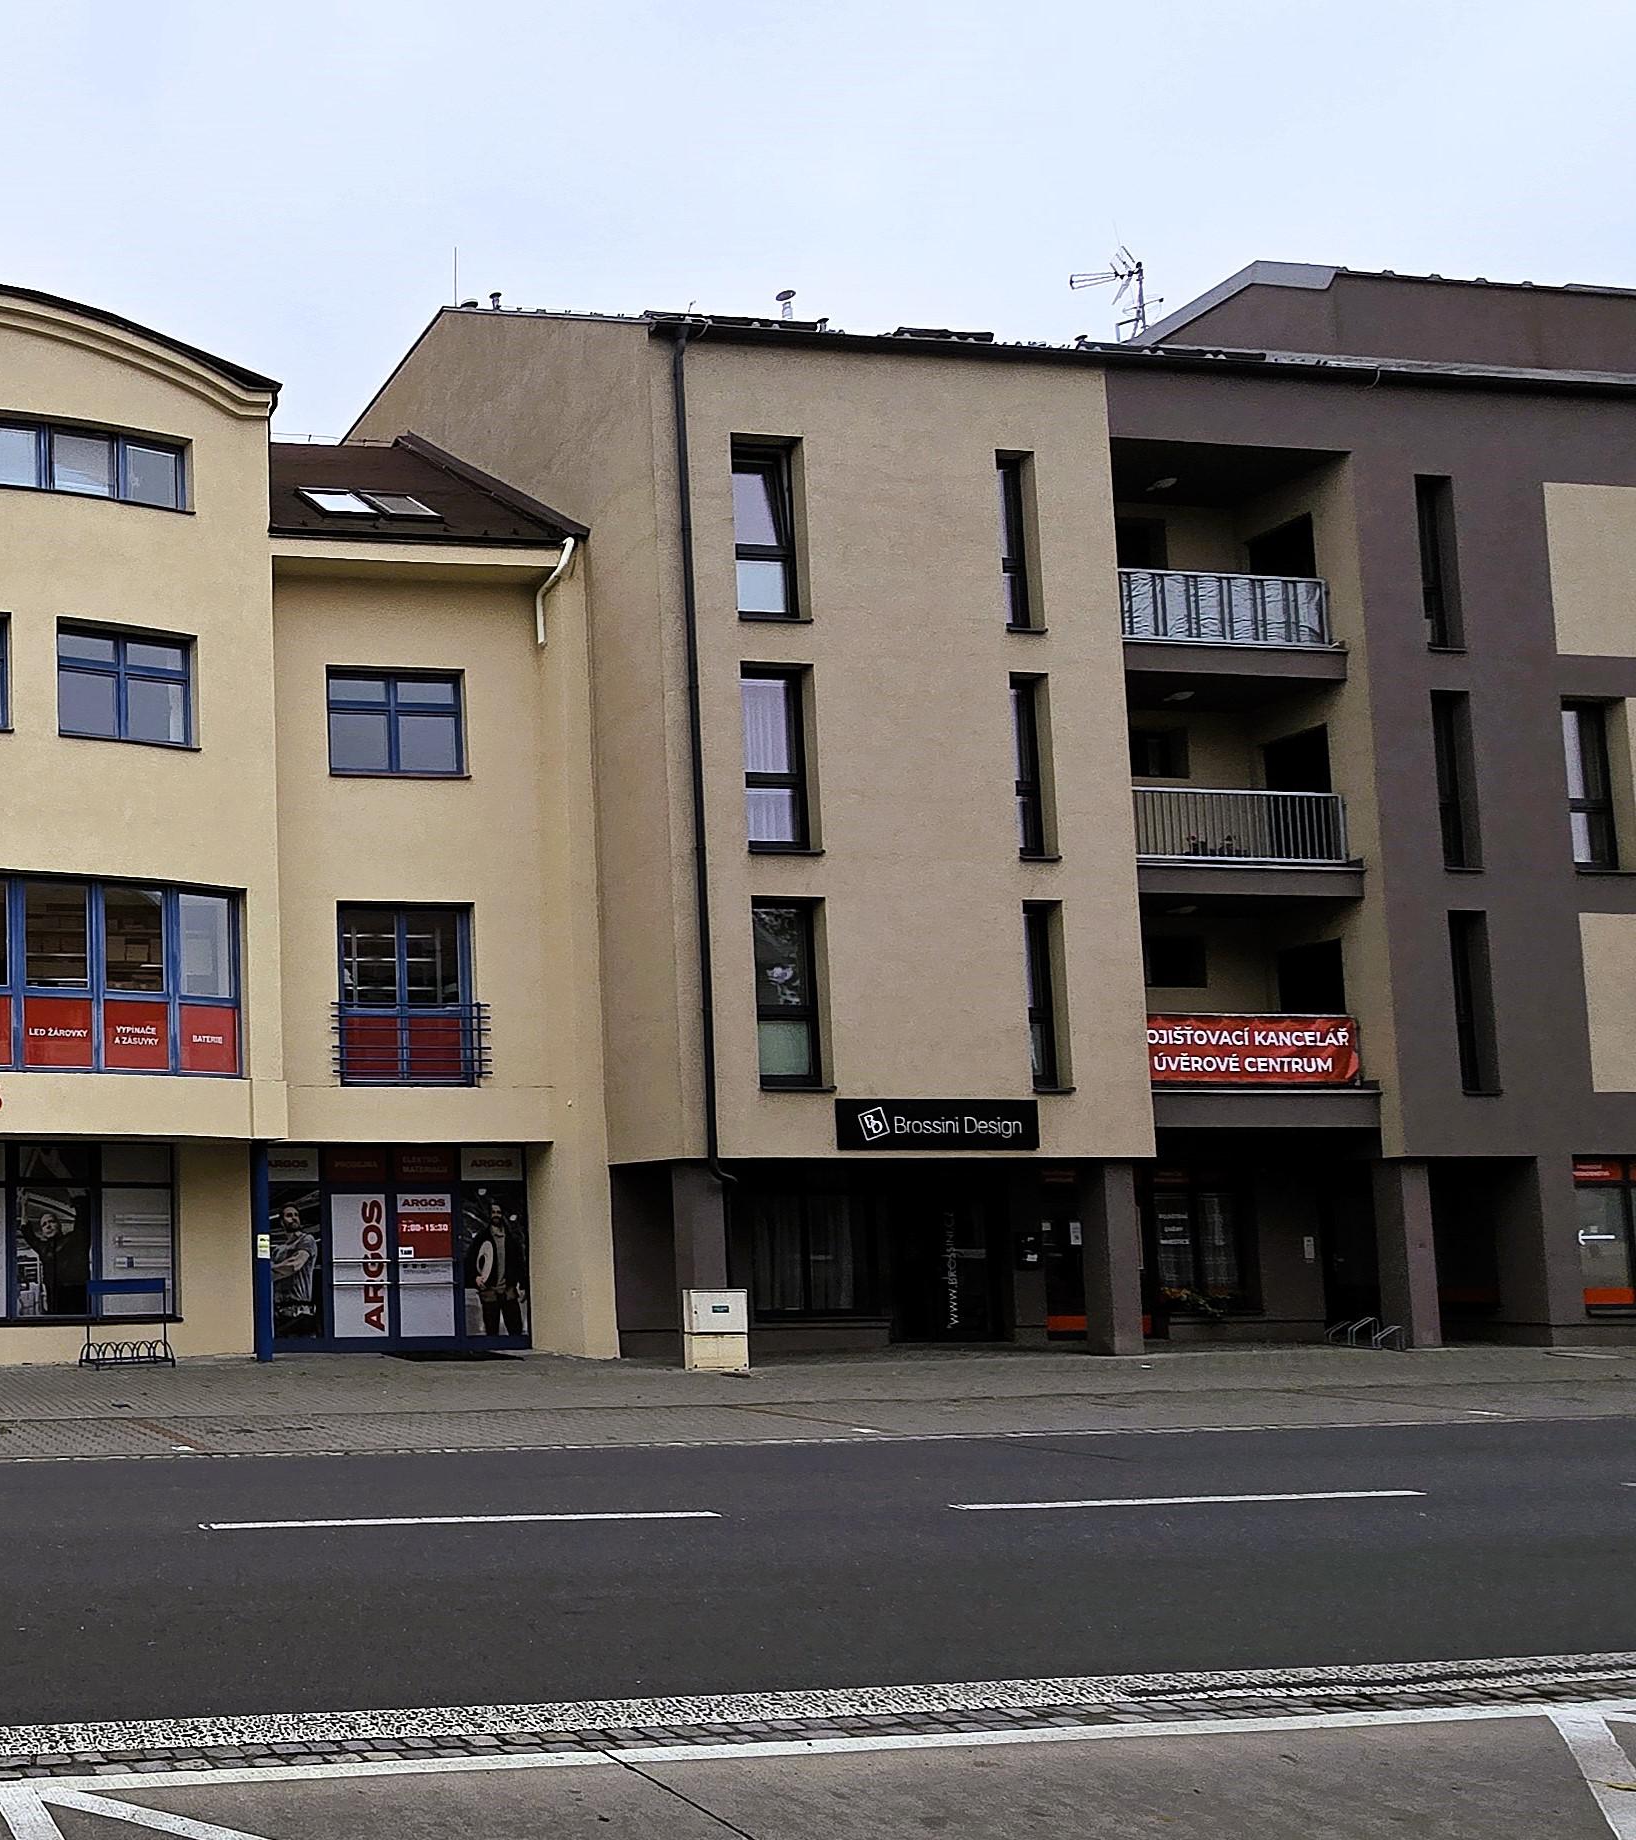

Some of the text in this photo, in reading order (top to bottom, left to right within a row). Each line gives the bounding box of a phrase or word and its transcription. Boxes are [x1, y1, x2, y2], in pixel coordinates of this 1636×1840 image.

[28, 1027, 88, 1038] LED ŽÁROVKY
[116, 1025, 157, 1035] VYPÍNAČE
[114, 1035, 159, 1046] A ZÁSUVKY
[1147, 1026, 1349, 1046] OJIŠŤOVACÍ KANCELÁŘ
[1154, 1052, 1333, 1073] ÚVĚROVÉ CENTRUM
[894, 1116, 960, 1134] Brossini
[964, 1116, 1023, 1138] Design
[470, 1159, 513, 1168] ARGOS
[402, 1199, 446, 1207] ARGOS
[361, 1200, 385, 1332] ARGOS
